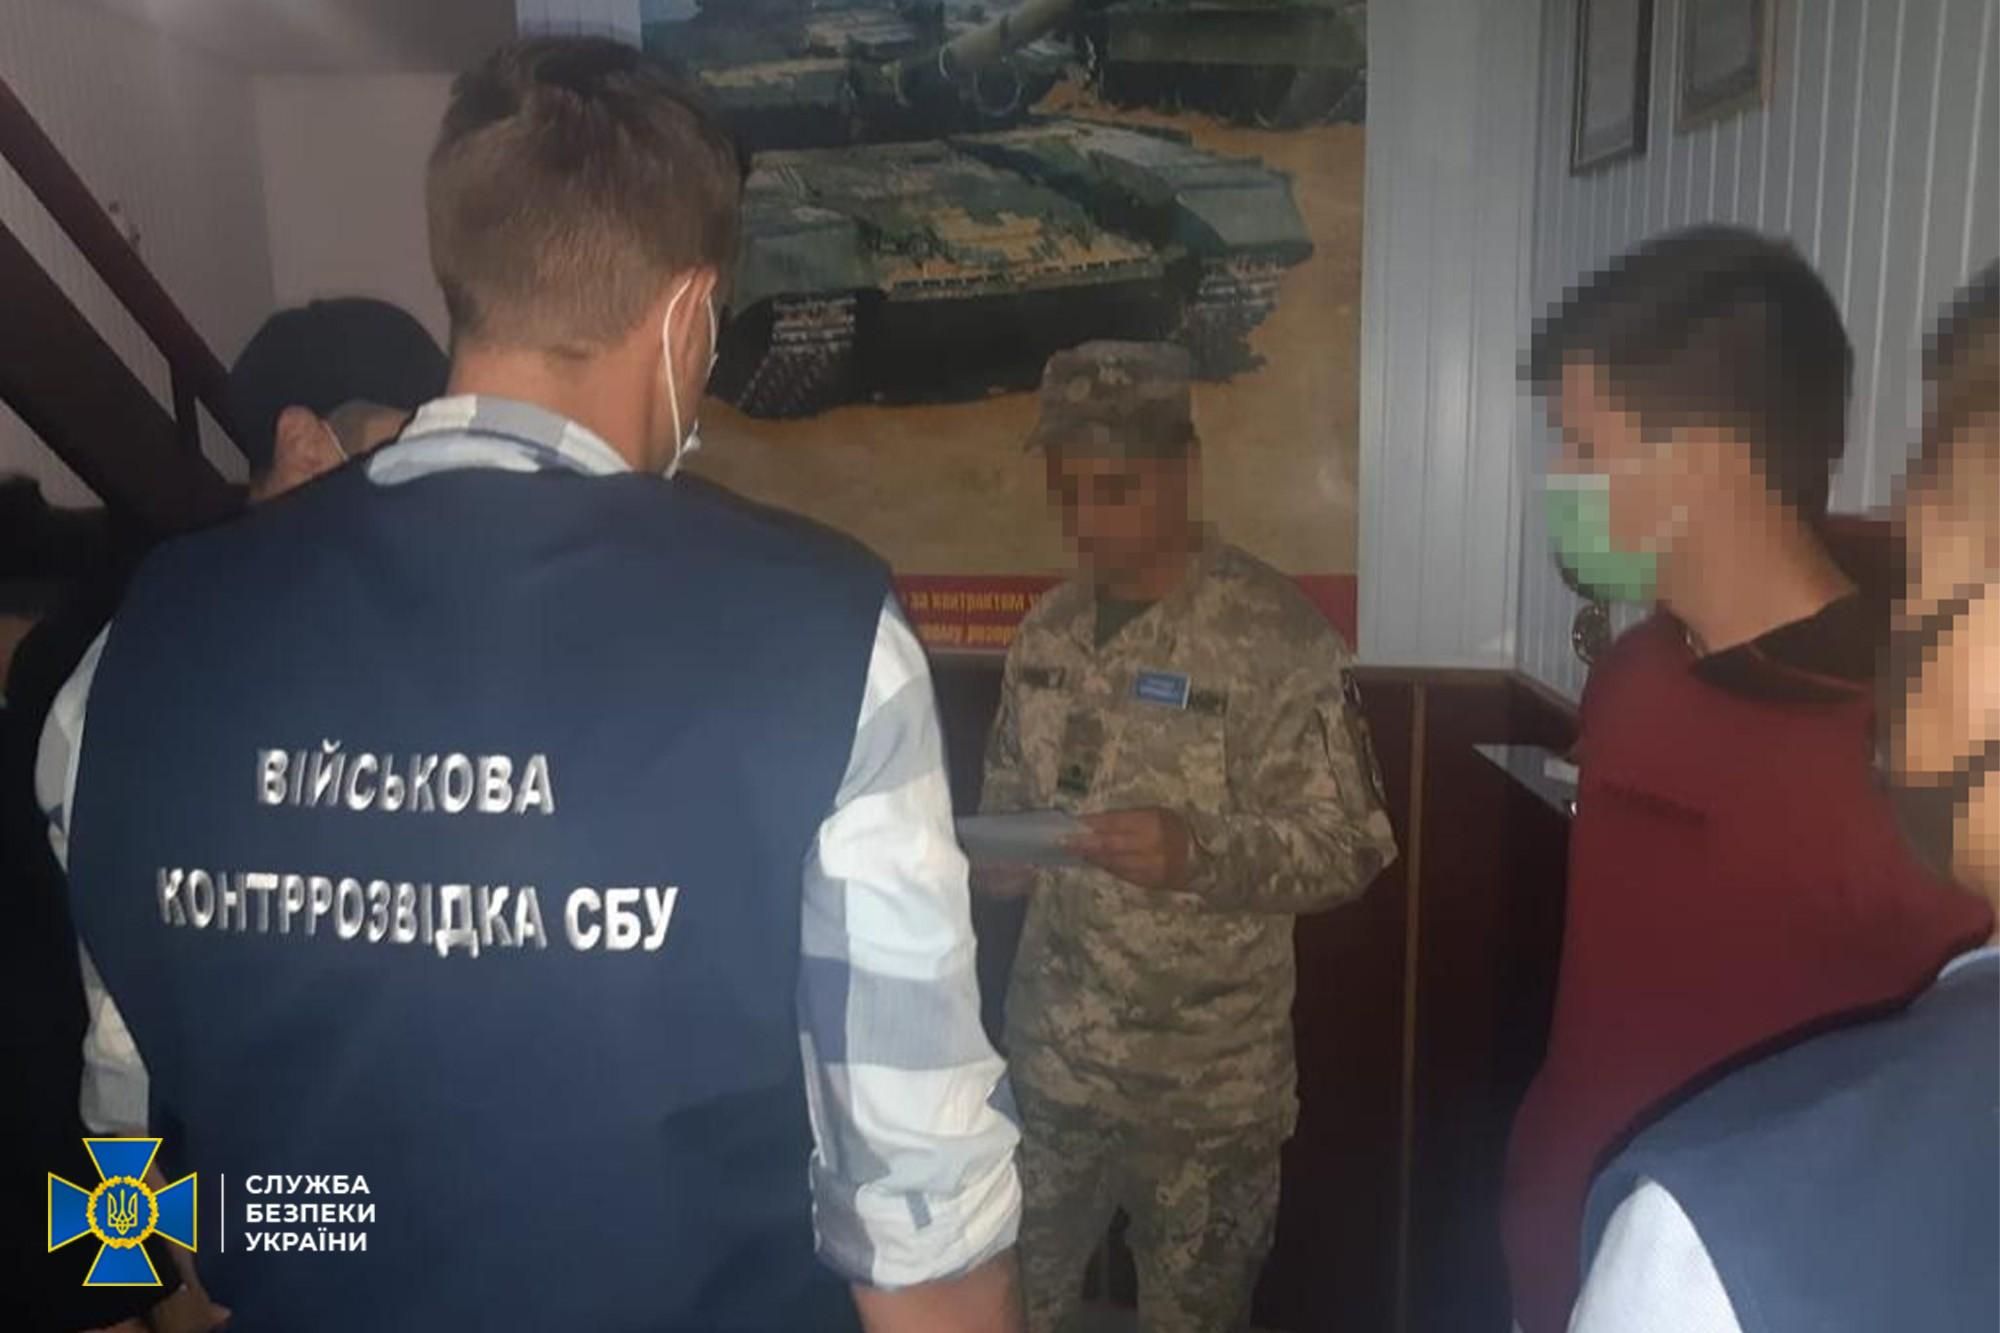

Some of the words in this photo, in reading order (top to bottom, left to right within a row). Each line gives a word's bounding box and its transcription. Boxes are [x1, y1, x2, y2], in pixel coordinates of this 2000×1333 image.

[257, 738, 556, 816] ВІЙСЬКОВА
[157, 866, 549, 960] КОНТРРОЗВІДКА
[564, 885, 680, 953] СБУ
